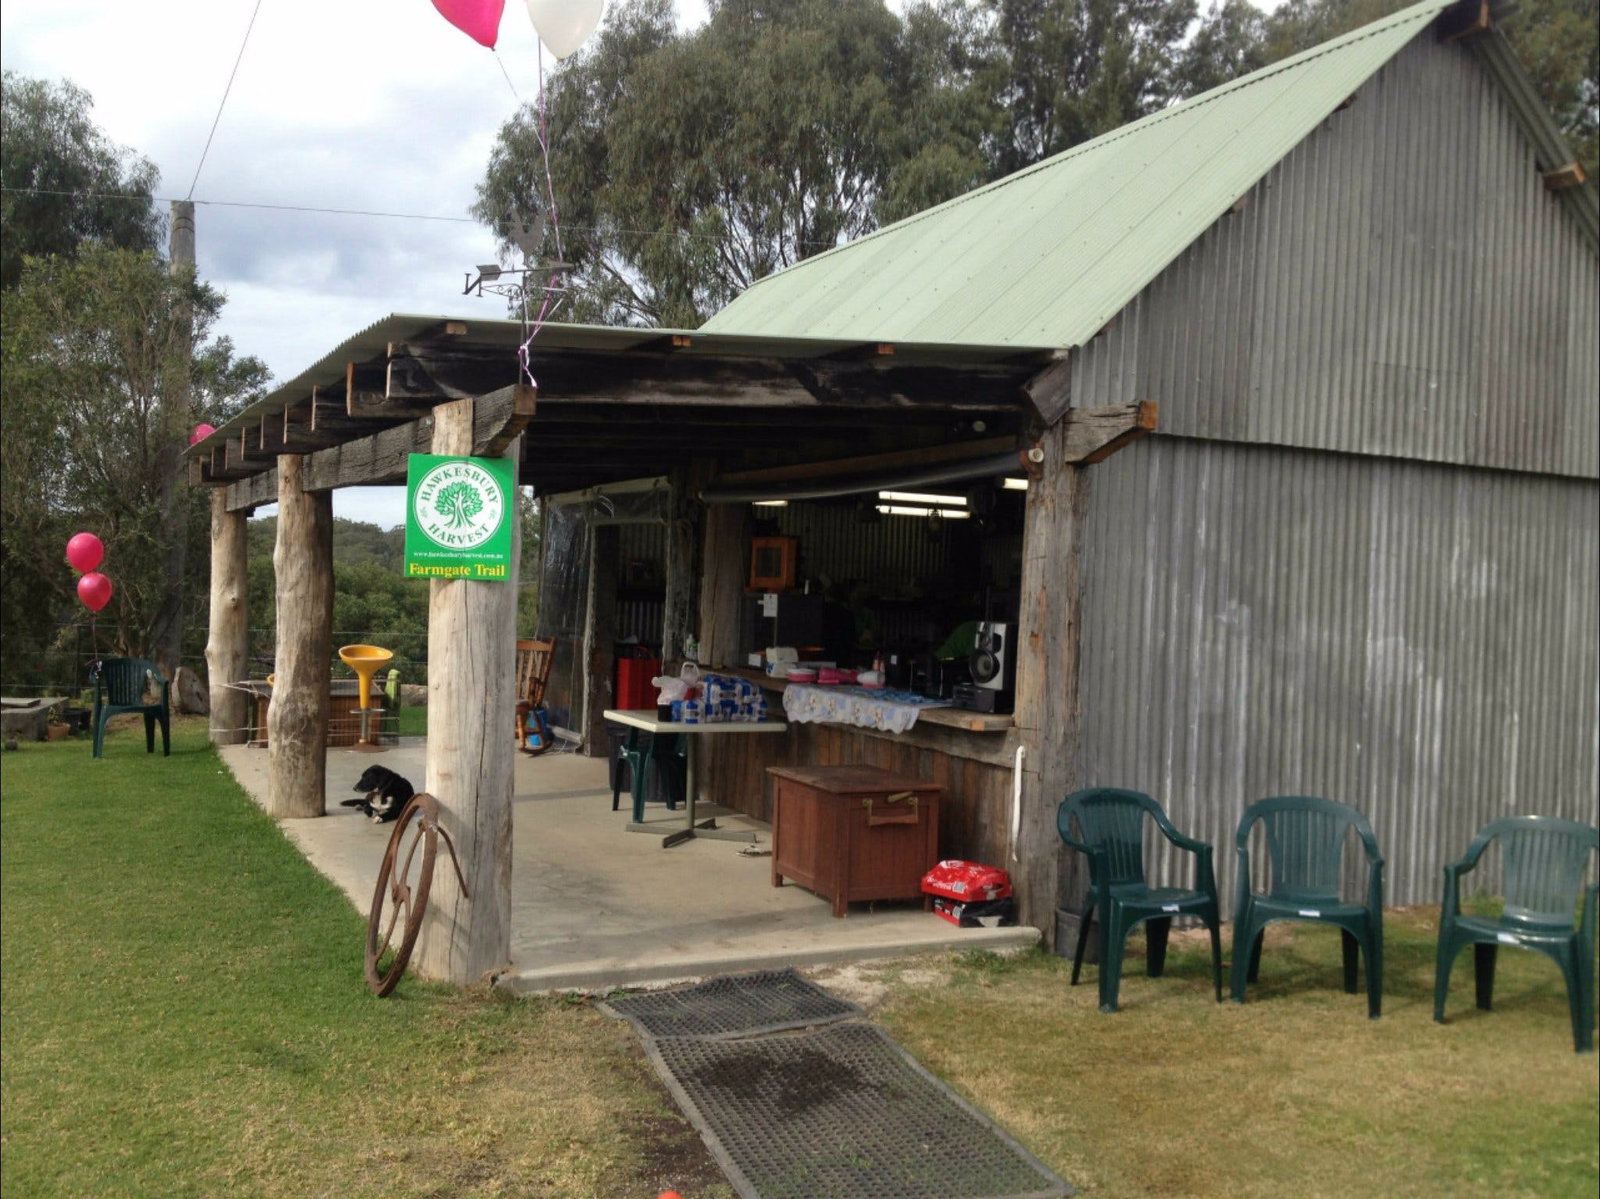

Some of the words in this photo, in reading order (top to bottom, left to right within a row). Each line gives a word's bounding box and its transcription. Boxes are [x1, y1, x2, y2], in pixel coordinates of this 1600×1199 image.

[421, 467, 499, 504] HAWKESBURY
[428, 523, 489, 544] HARVEST
[409, 563, 471, 578] Farmgate
[474, 563, 505, 577] Trail
